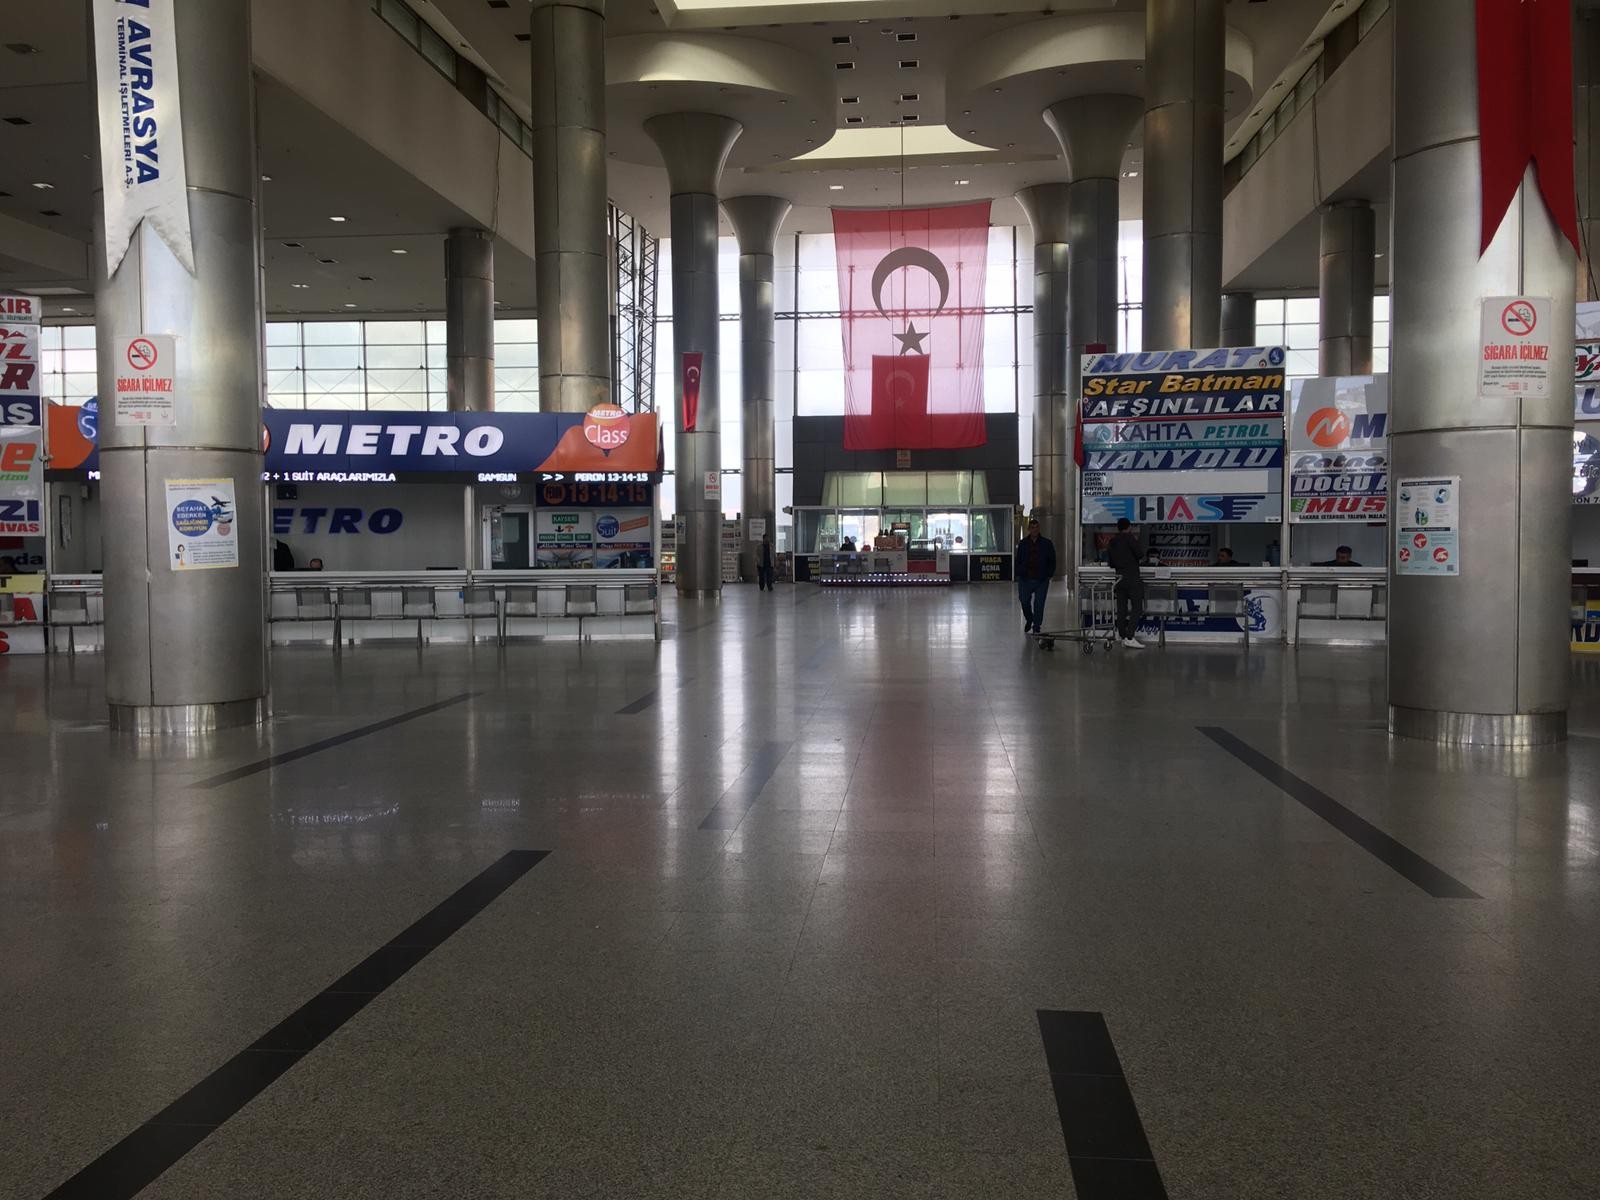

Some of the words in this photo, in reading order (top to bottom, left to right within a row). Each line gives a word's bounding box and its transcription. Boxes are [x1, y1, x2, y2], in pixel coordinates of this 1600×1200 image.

[117, 17, 126, 79] TERMİNAL
[127, 19, 160, 184] AVRASYA
[120, 82, 134, 162] İŞLETMELERİ
[1090, 346, 1266, 374] MURAT
[1484, 342, 1518, 360] SİGARA
[1520, 341, 1549, 361] İÇİLMEZ
[0, 363, 36, 390] R
[118, 375, 141, 392] SİGARA
[142, 374, 173, 394] İÇİLMEZ
[1084, 376, 1153, 397] Star
[1160, 373, 1283, 394] Batman
[592, 409, 622, 417] METRO
[1089, 394, 1281, 418] AFŞINLILAR
[283, 424, 504, 457] METRO
[585, 425, 628, 444] Class
[1115, 422, 1193, 442] KAHTA
[1203, 424, 1270, 439] PETROL
[0, 443, 37, 472] e
[316, 472, 396, 482] ARAÇLARIMIZLA
[478, 472, 517, 481] SAMSUN
[574, 472, 606, 481] PERON
[607, 472, 648, 481] 13-14-15
[0, 523, 39, 533] IVAS
[273, 507, 404, 534] ETRO
